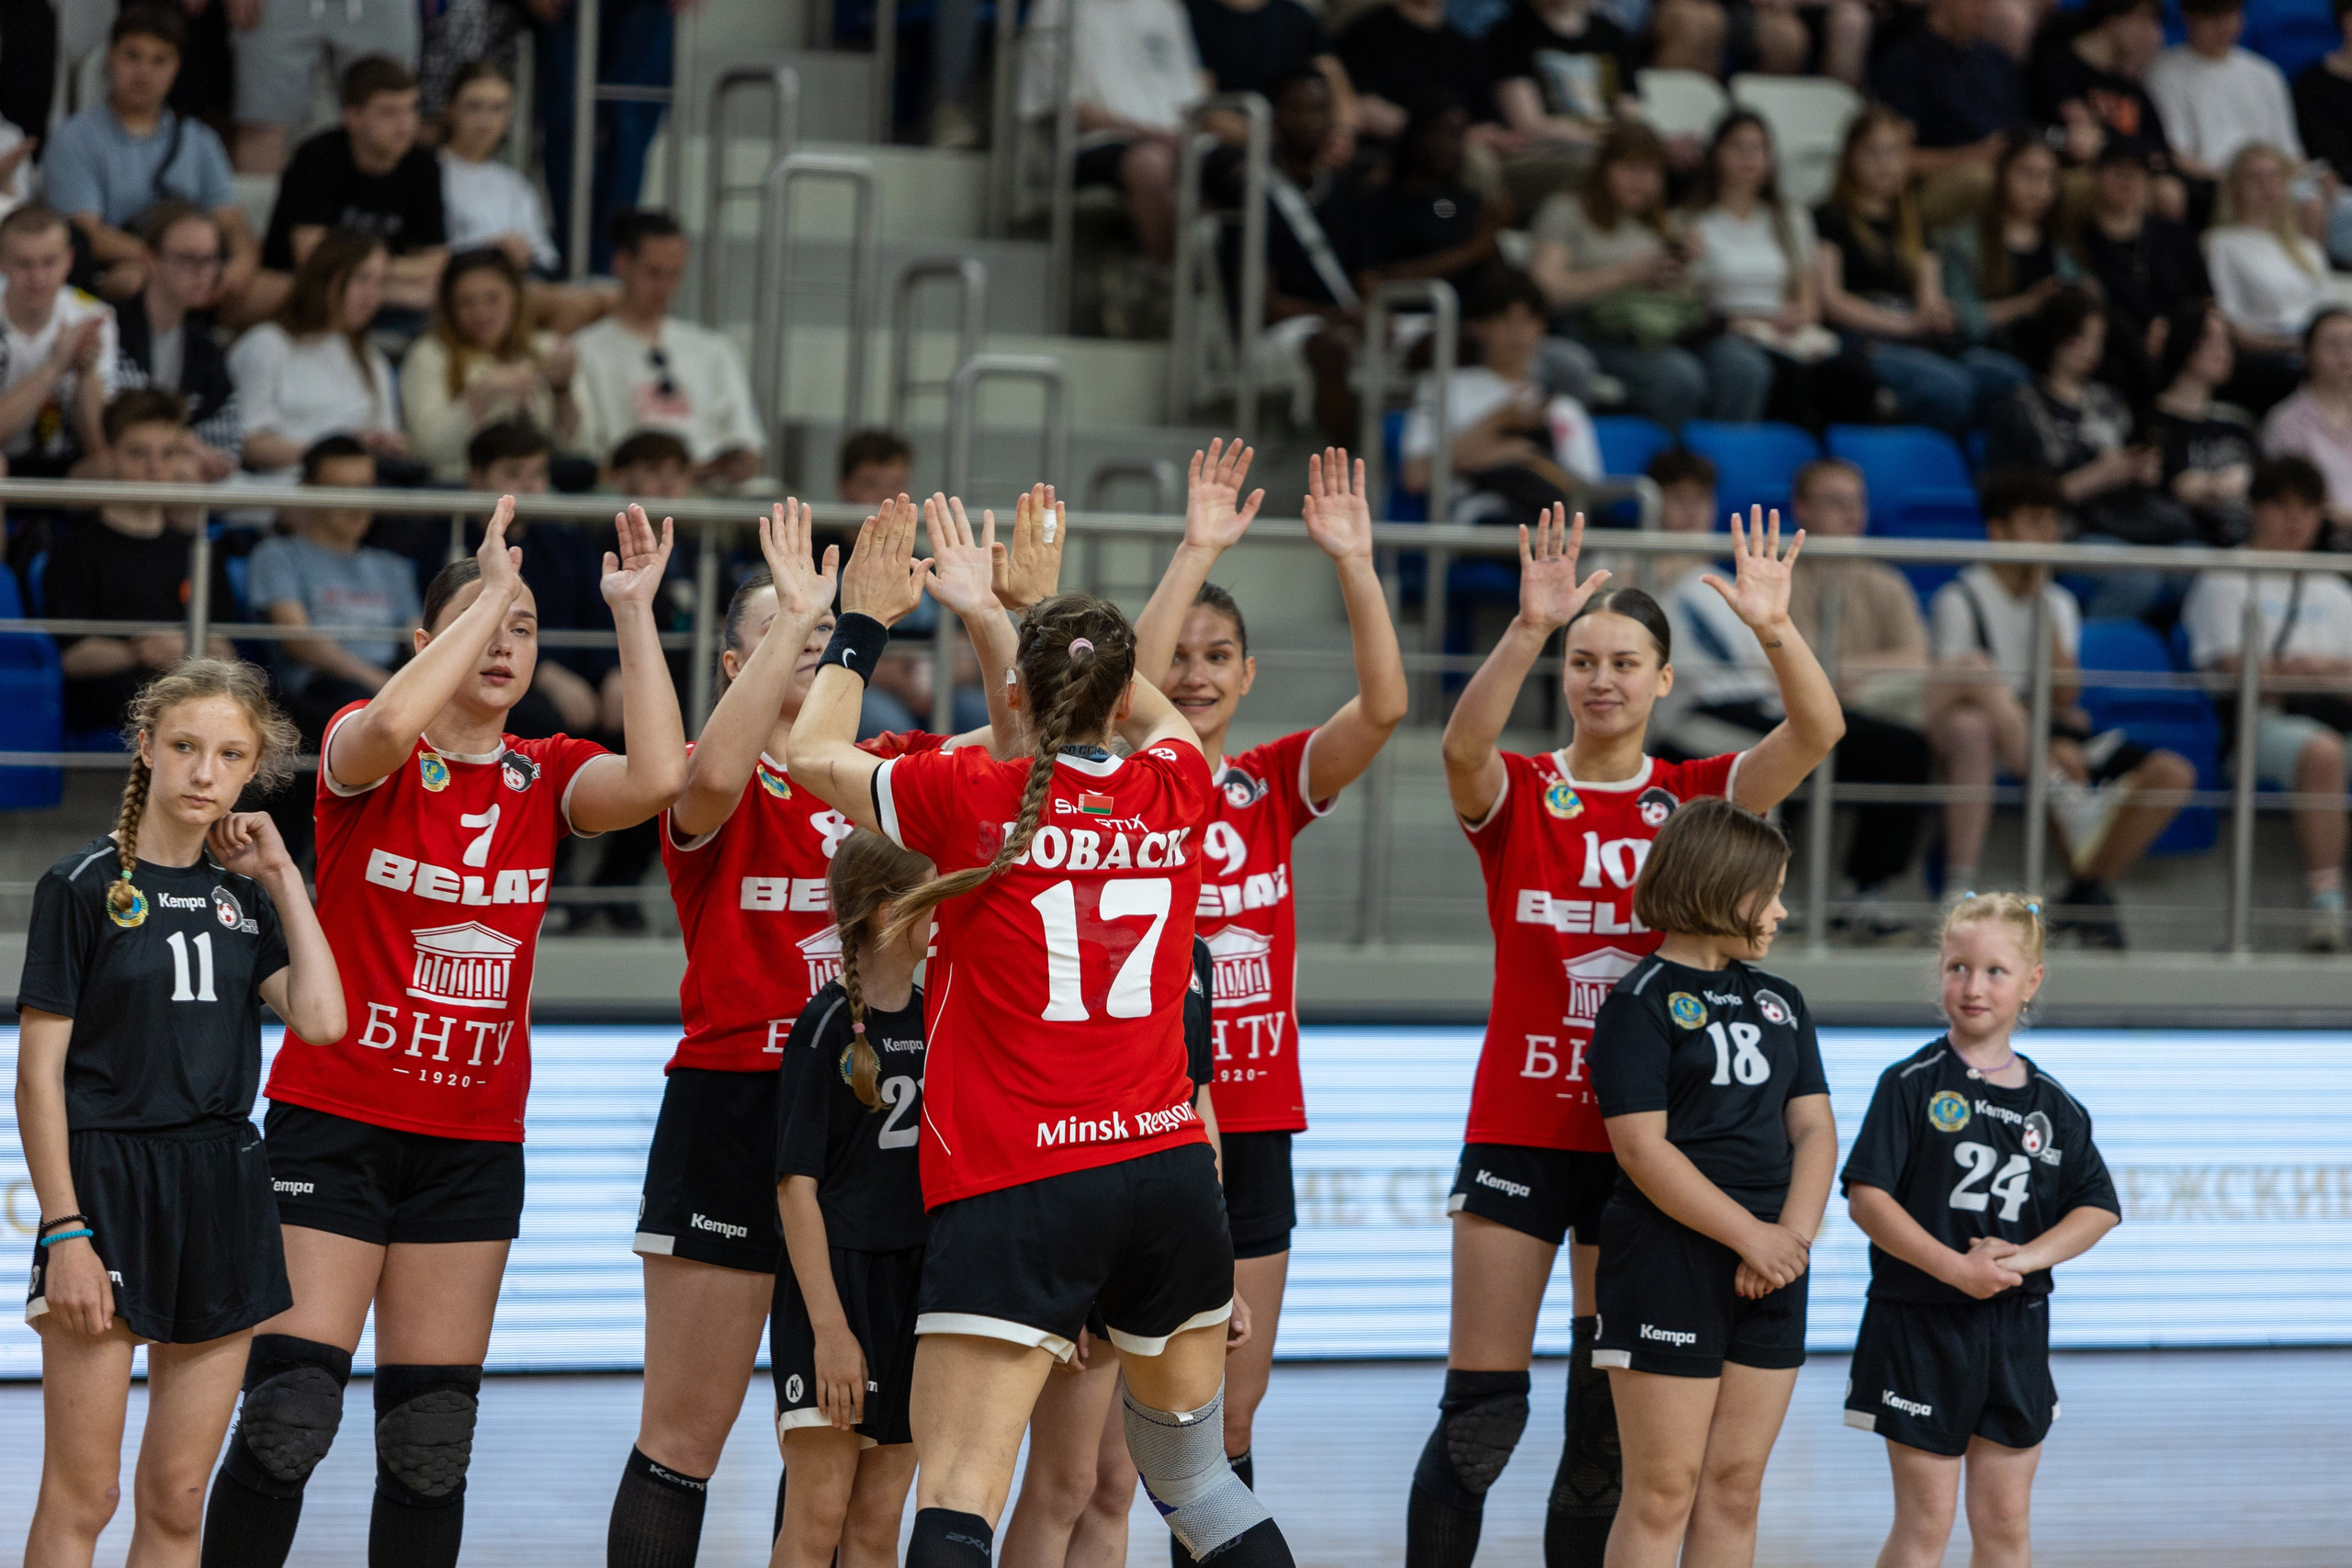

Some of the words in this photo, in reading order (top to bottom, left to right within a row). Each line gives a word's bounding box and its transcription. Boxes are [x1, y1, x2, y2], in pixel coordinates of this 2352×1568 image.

[460, 803, 501, 868] 7
[809, 808, 854, 859] 8
[1203, 821, 1248, 877] 9
[365, 848, 550, 906] BELAZ
[1578, 830, 1653, 889] 10
[158, 893, 207, 911] Kempa
[166, 931, 218, 1001] 11
[1031, 877, 1171, 1021] 17
[357, 1001, 514, 1066] БНТУ
[882, 1037, 924, 1054] Kempa
[1705, 1021, 1771, 1086] 18
[1036, 1111, 1129, 1147] Minsk
[1135, 1101, 1196, 1135] Region
[1975, 1100, 2022, 1125] Kempa
[271, 1177, 315, 1196] empa
[1476, 1168, 1531, 1198] Kempa
[1949, 1141, 2031, 1222] 24
[691, 1213, 748, 1238] Kempa
[1640, 1324, 1697, 1347] Kempa
[1882, 1389, 1932, 1416] Kempa
